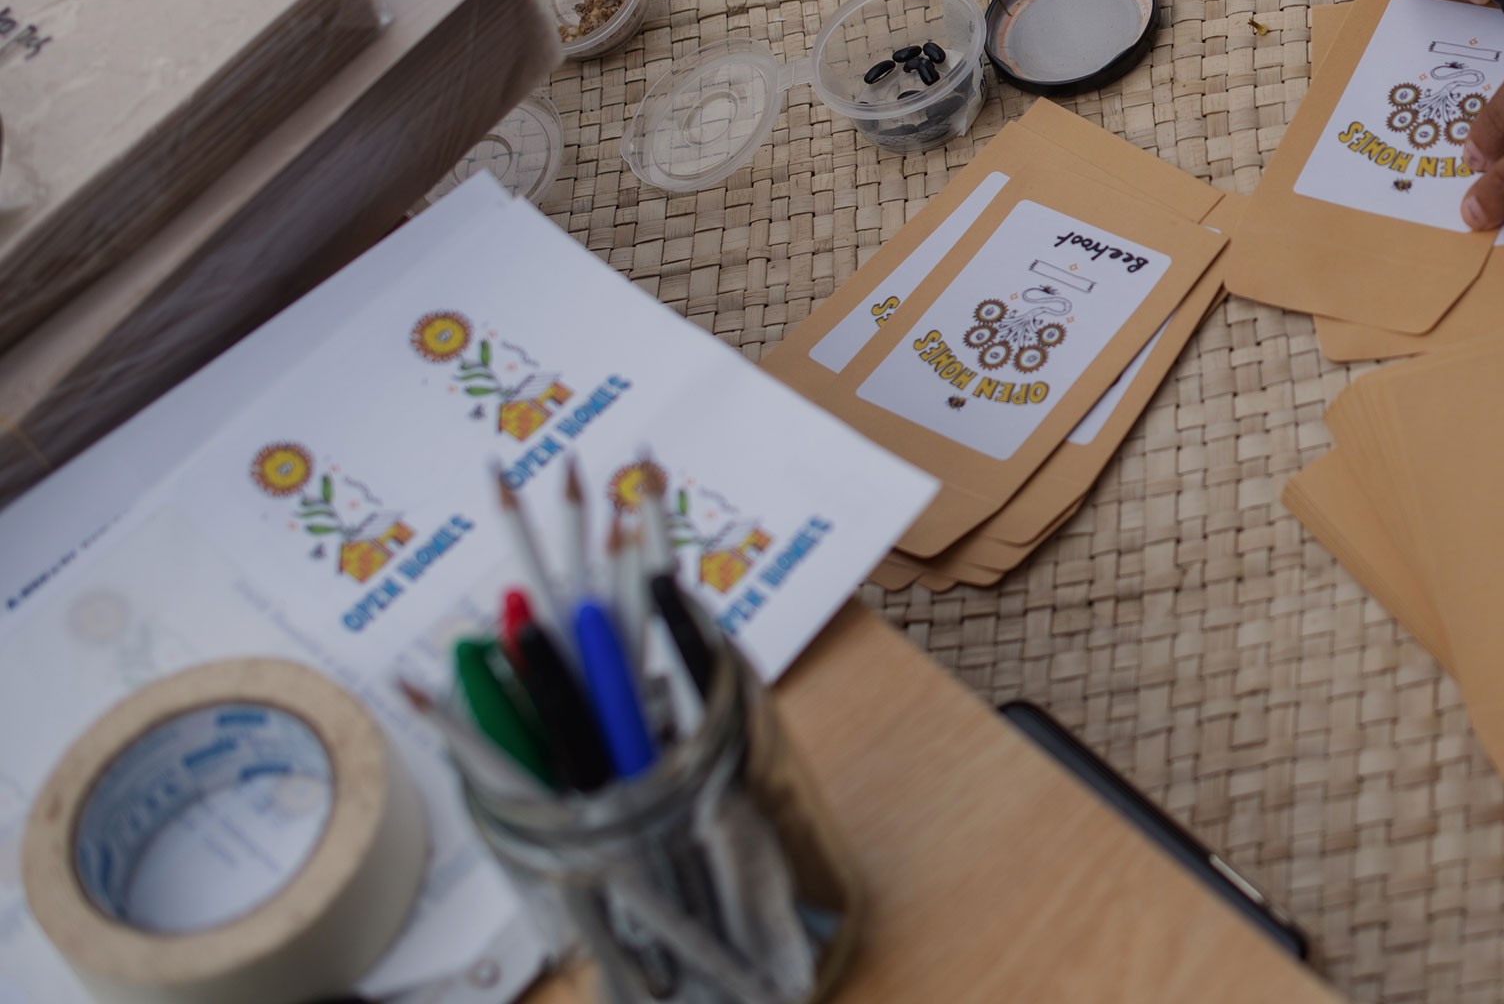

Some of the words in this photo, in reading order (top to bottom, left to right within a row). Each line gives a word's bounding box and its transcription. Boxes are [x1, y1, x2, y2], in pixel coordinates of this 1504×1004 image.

[1338, 120, 1414, 174] HOMES
[1415, 155, 1477, 178] PEN
[912, 329, 978, 391] HOMES
[971, 375, 1051, 405] OPEN
[502, 432, 563, 493] OPEN
[555, 374, 632, 439] HOMES
[341, 574, 405, 633] OPEN
[396, 513, 475, 582] HOMES
[759, 515, 833, 588] HOMES
